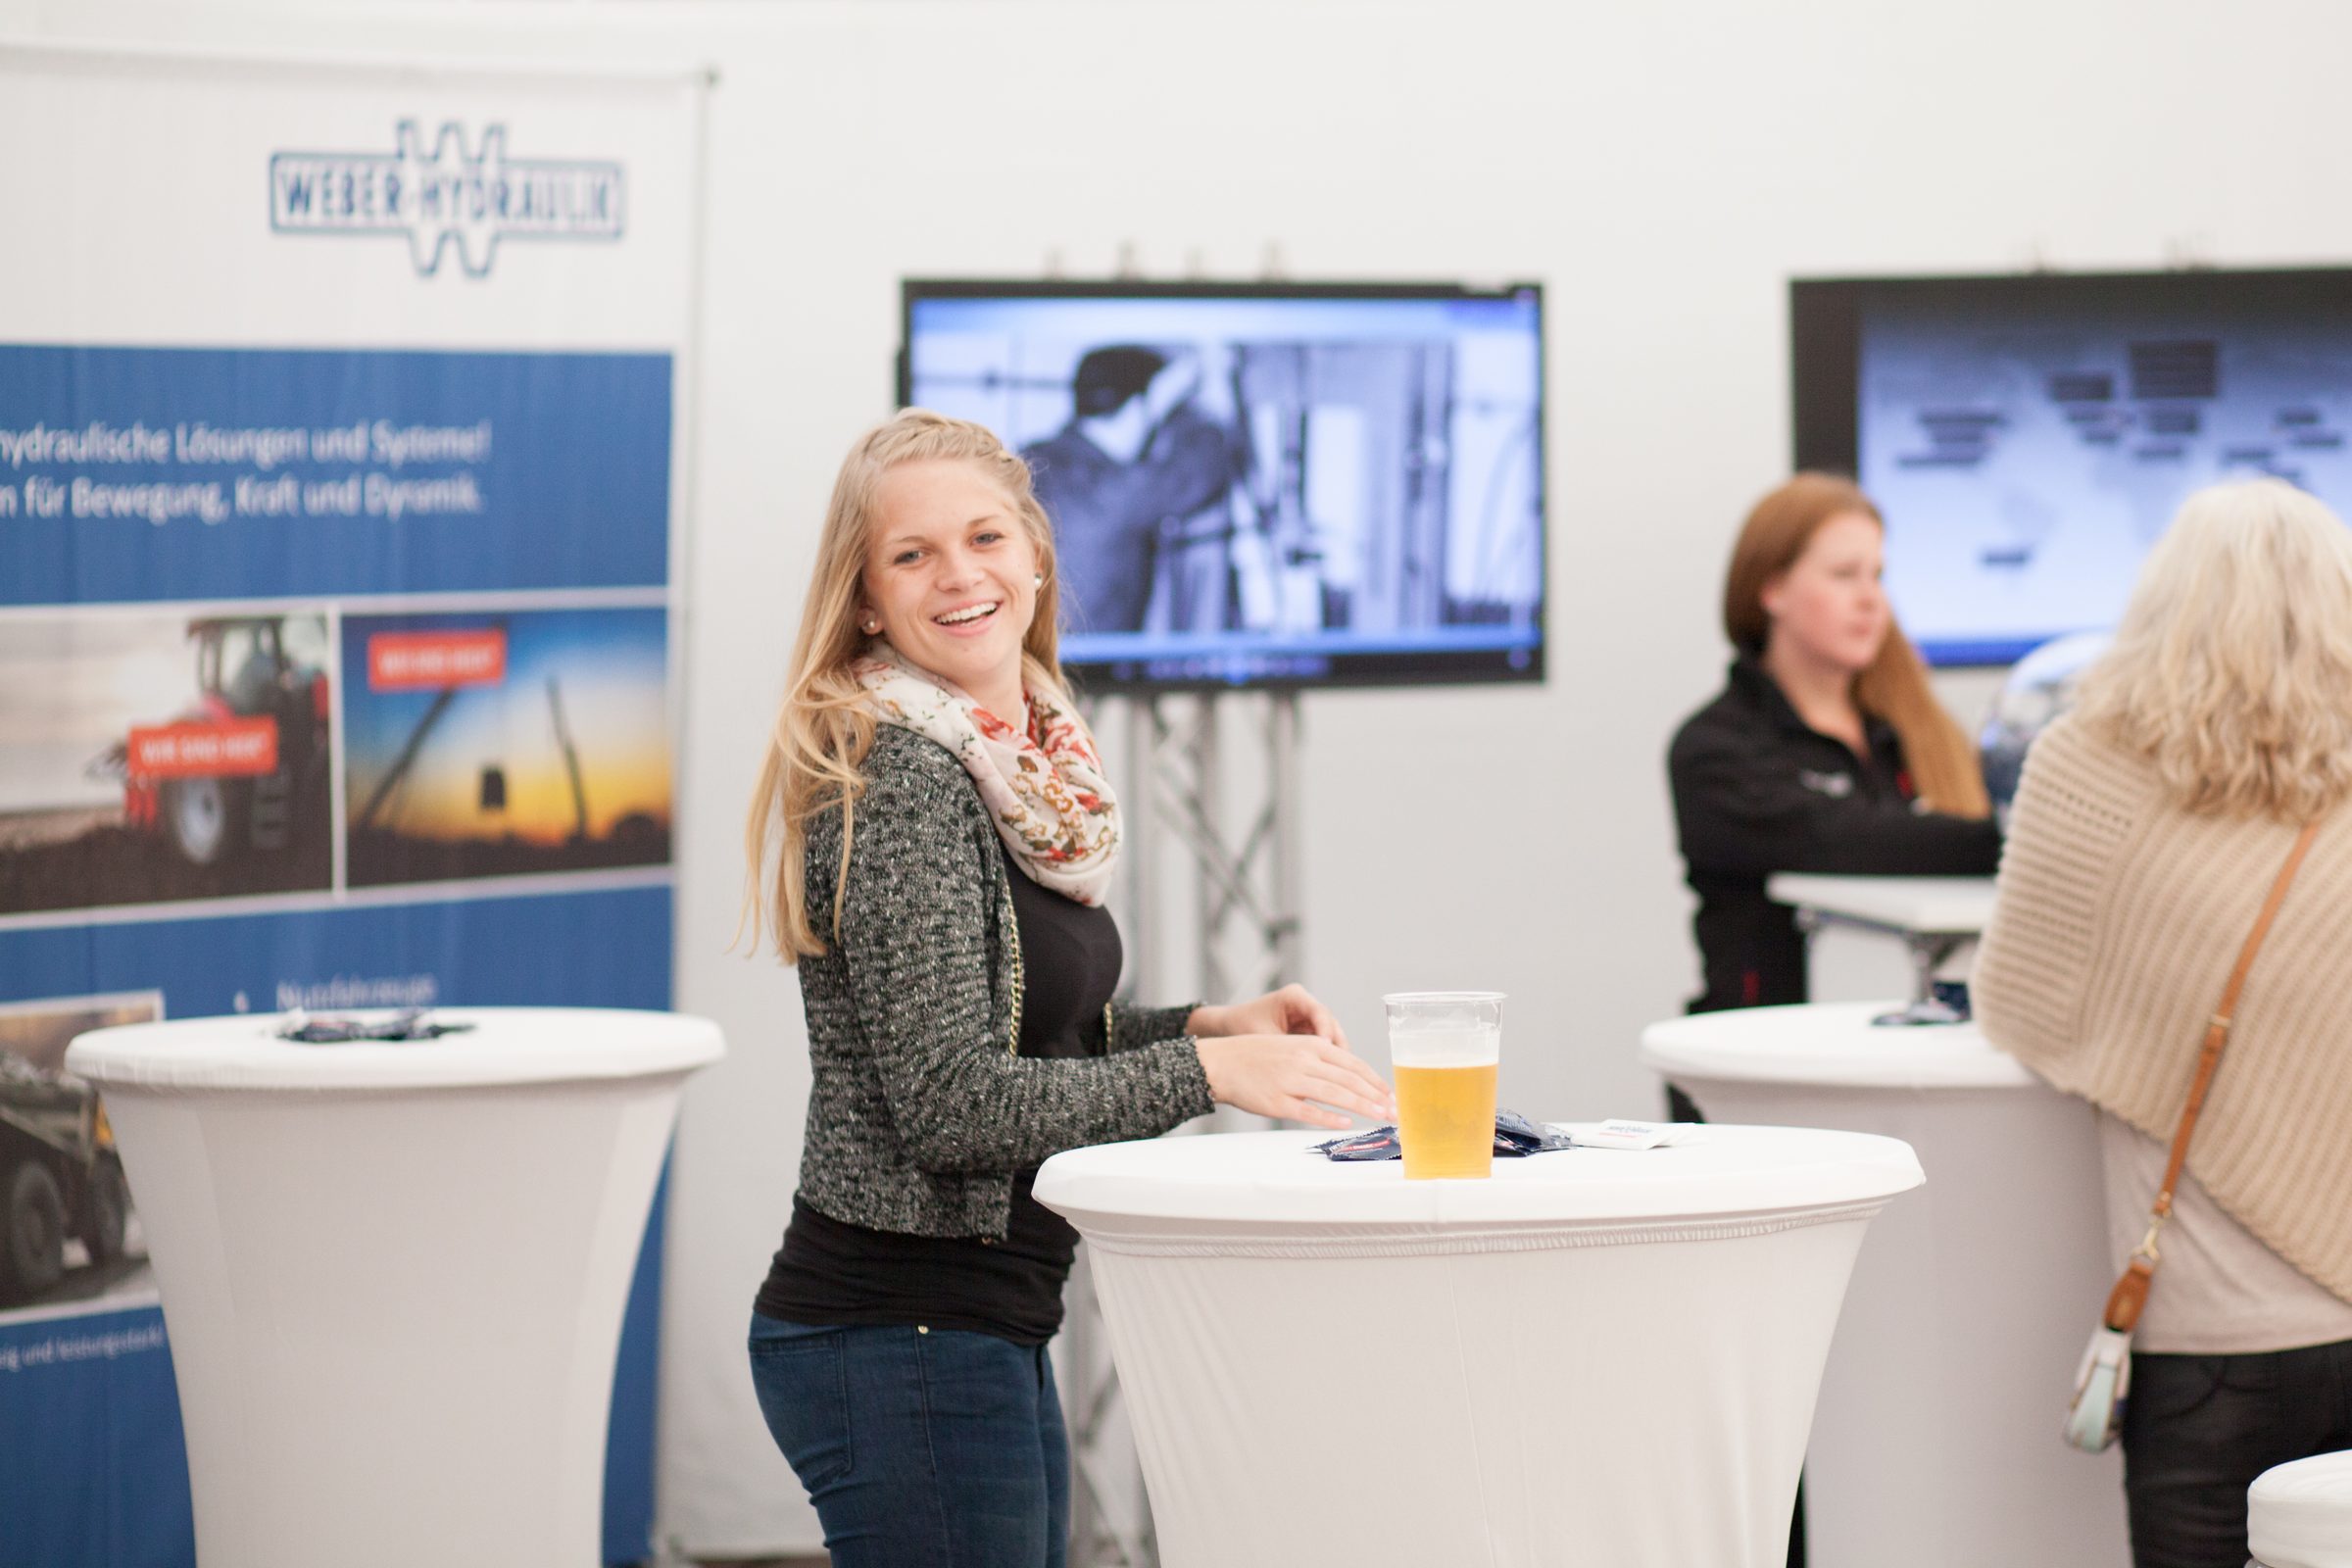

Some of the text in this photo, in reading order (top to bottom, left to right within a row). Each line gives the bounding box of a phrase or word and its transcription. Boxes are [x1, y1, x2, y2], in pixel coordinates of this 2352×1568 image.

[174, 420, 308, 471] Lösungen
[311, 418, 369, 465] und
[24, 474, 66, 517] für
[72, 475, 230, 526] Bewegung,
[235, 472, 299, 517] Kraft
[304, 470, 362, 516] und
